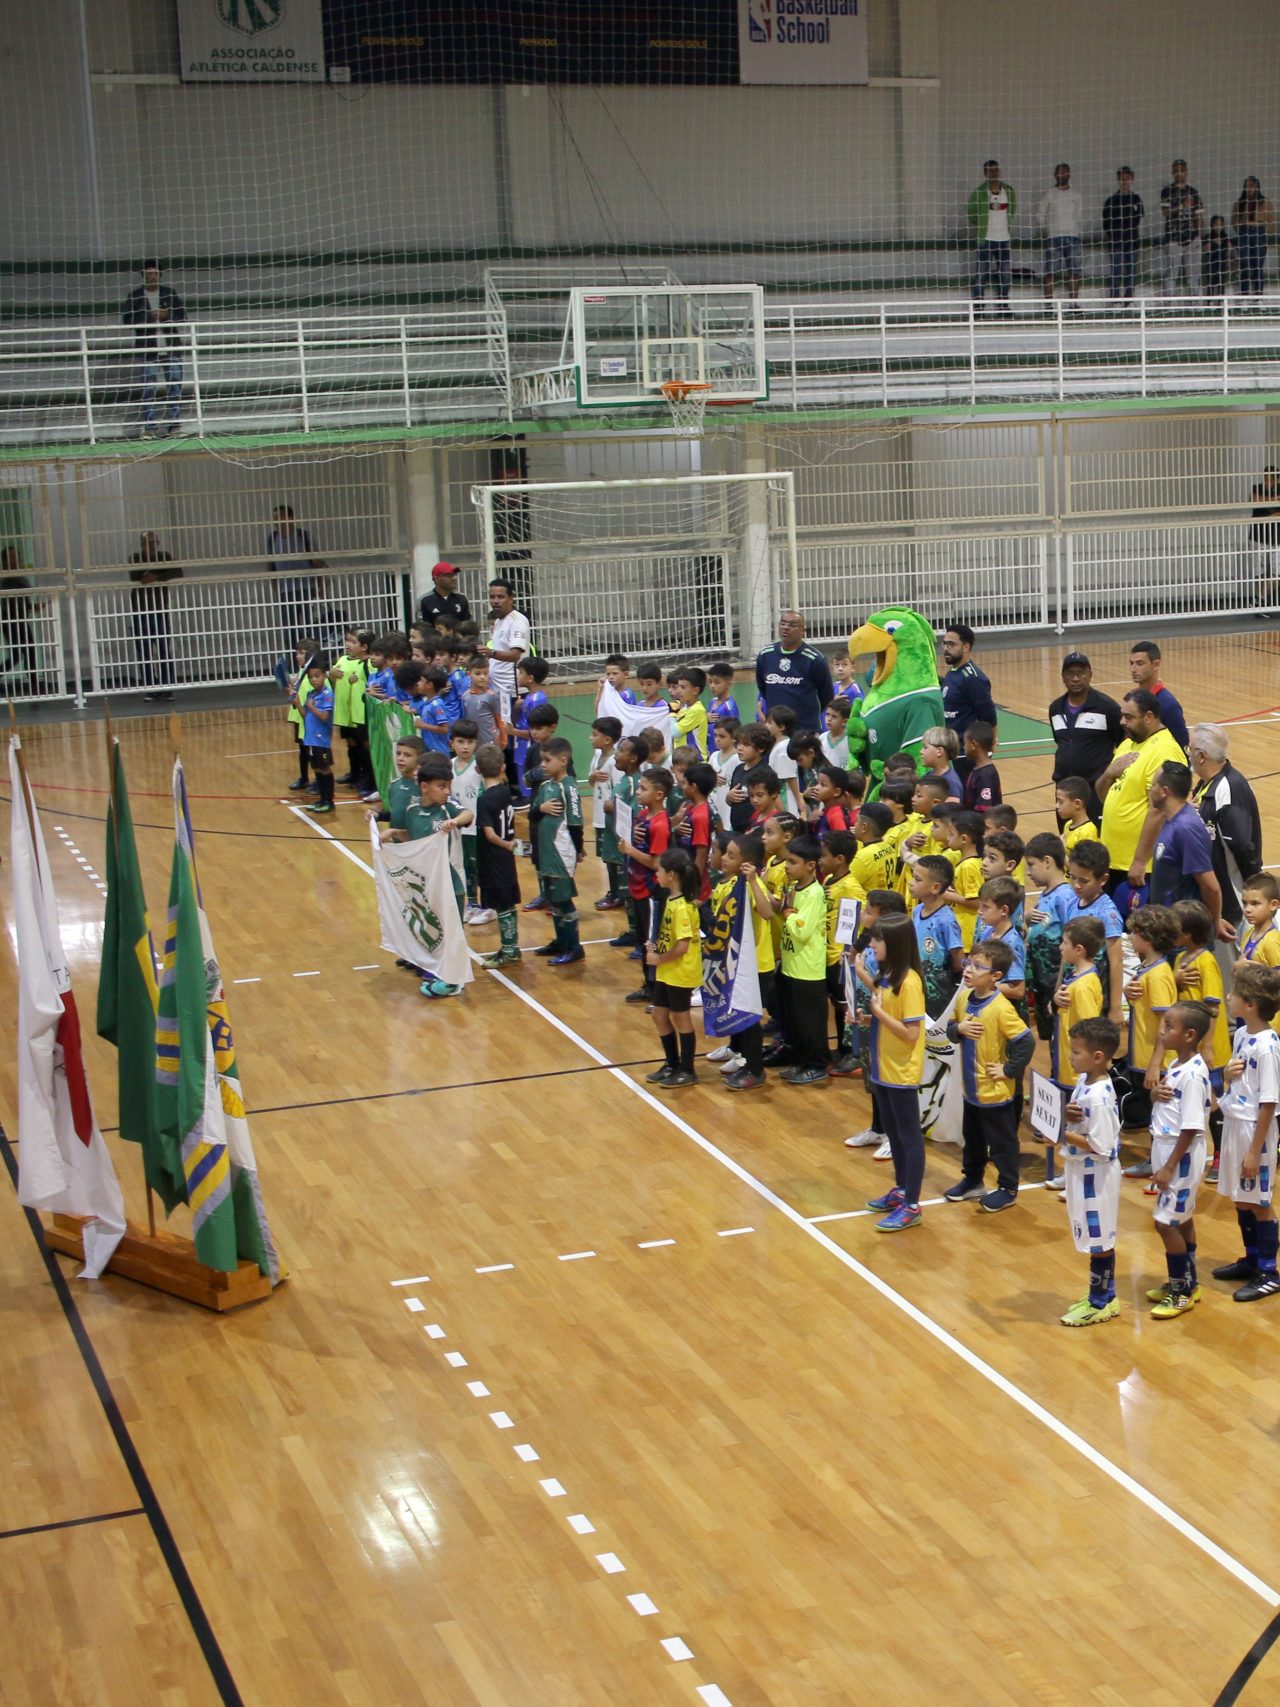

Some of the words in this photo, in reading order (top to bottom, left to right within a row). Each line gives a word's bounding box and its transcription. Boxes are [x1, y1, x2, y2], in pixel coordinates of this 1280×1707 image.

[777, 16, 830, 44] School
[211, 47, 295, 61] ASSOCIAÇÃO
[189, 59, 248, 73] ATLÉTICA
[252, 62, 319, 73] CALDENSE
